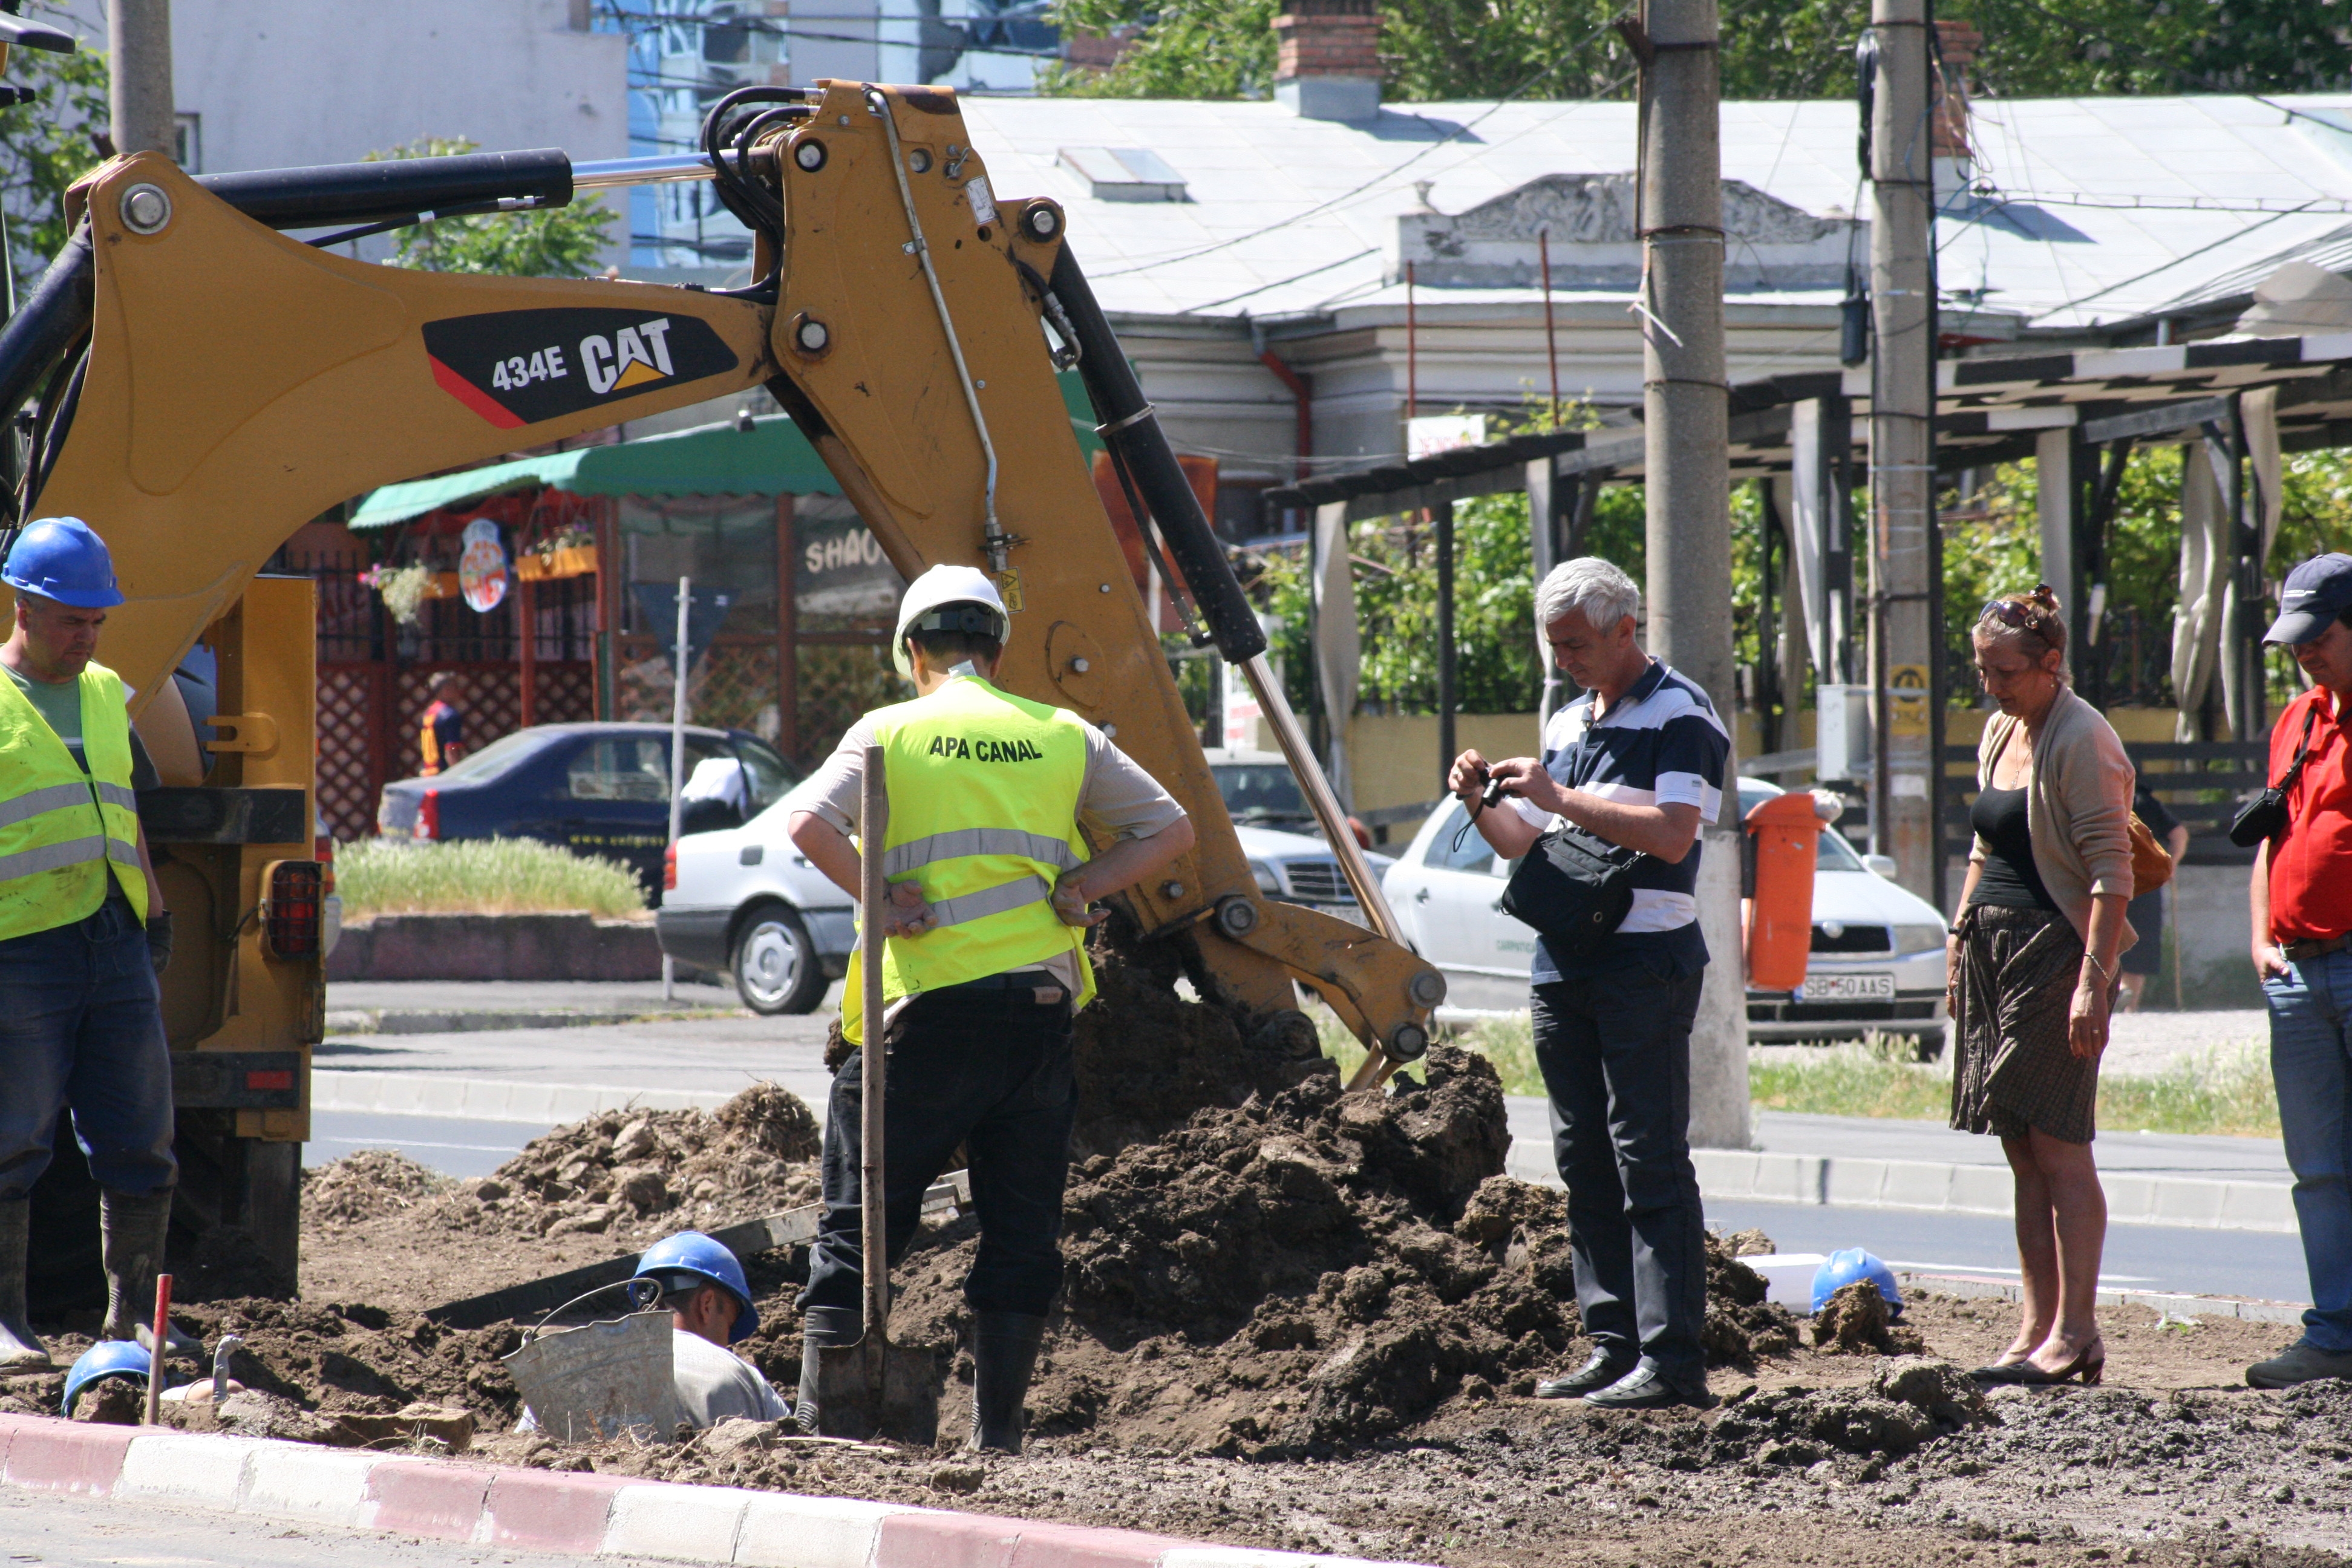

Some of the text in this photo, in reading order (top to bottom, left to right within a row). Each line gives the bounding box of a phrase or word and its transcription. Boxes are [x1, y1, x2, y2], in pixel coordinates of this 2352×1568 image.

[492, 345, 567, 391] 434E
[579, 318, 675, 394] CAT
[805, 528, 890, 573] SHAO
[929, 736, 1043, 762] APA CANAL
[1805, 978, 1828, 996] SB
[1859, 978, 1890, 995] AAS
